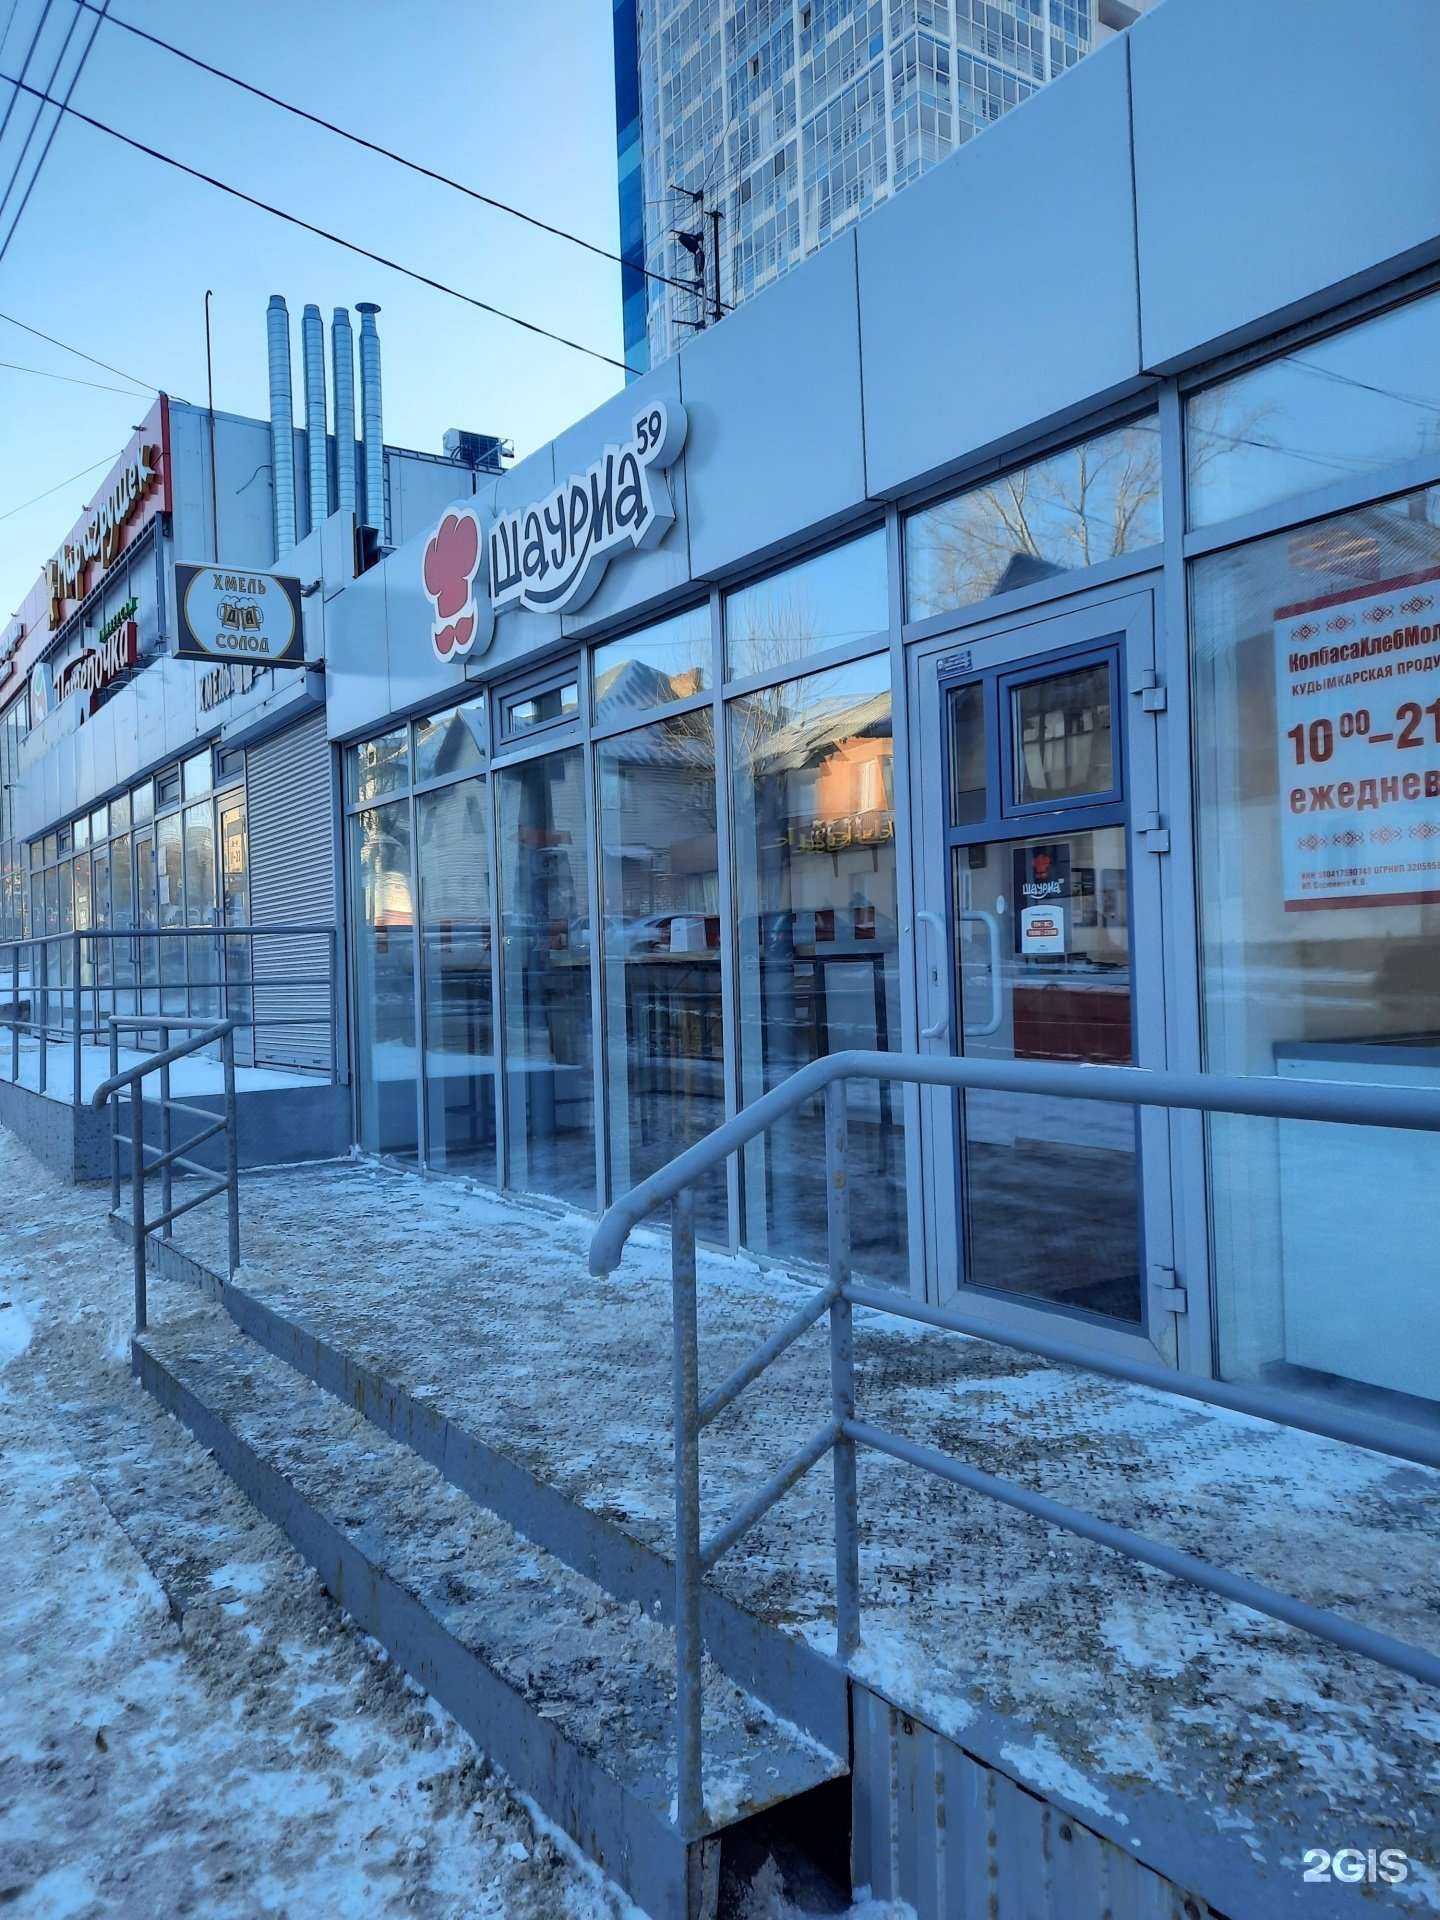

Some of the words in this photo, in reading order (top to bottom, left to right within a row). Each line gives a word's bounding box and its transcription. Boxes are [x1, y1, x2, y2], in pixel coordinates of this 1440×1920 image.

[213, 574, 267, 595] ХМЕЛЬ
[216, 633, 270, 653] СОЛОД
[1292, 664, 1394, 697] КУДЫМКАРСКАЯ
